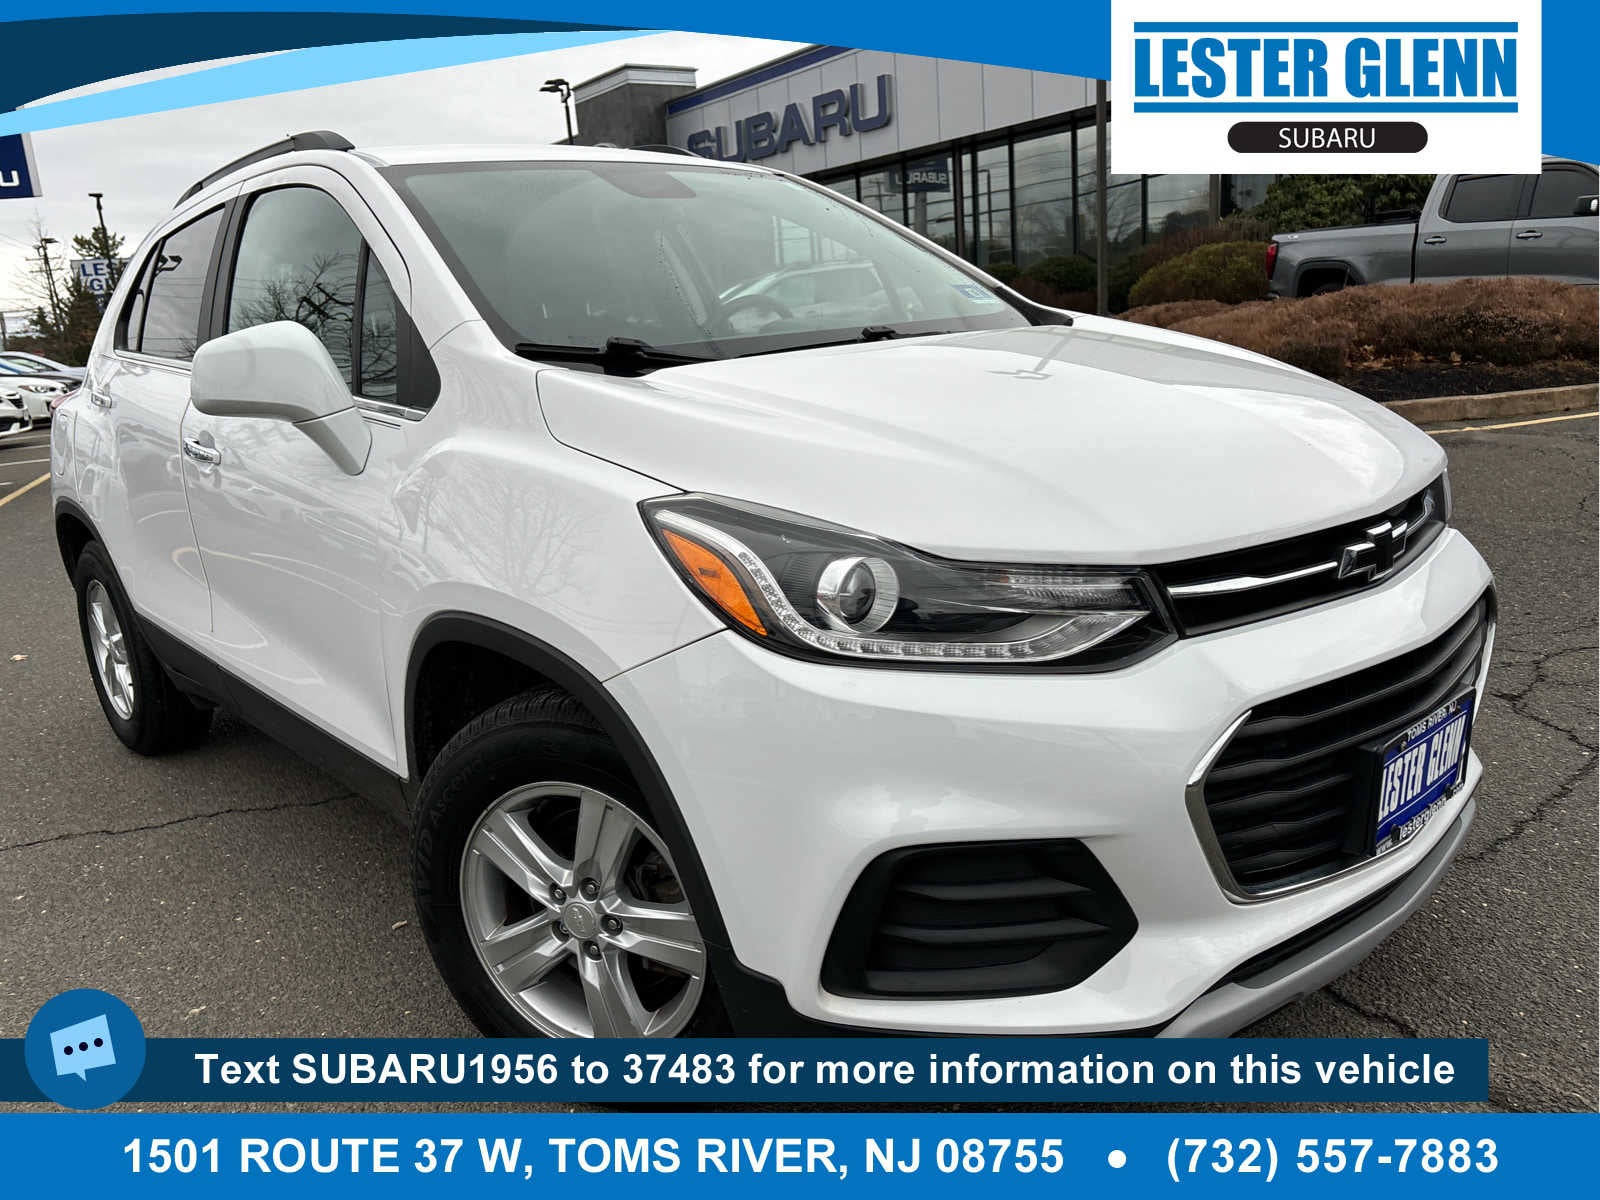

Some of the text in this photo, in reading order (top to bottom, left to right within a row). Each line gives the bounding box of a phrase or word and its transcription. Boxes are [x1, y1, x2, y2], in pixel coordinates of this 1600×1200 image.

[687, 74, 893, 162] SUBARU
[1378, 714, 1467, 822] LESTER GLENN
[1407, 720, 1427, 742] TOMS
